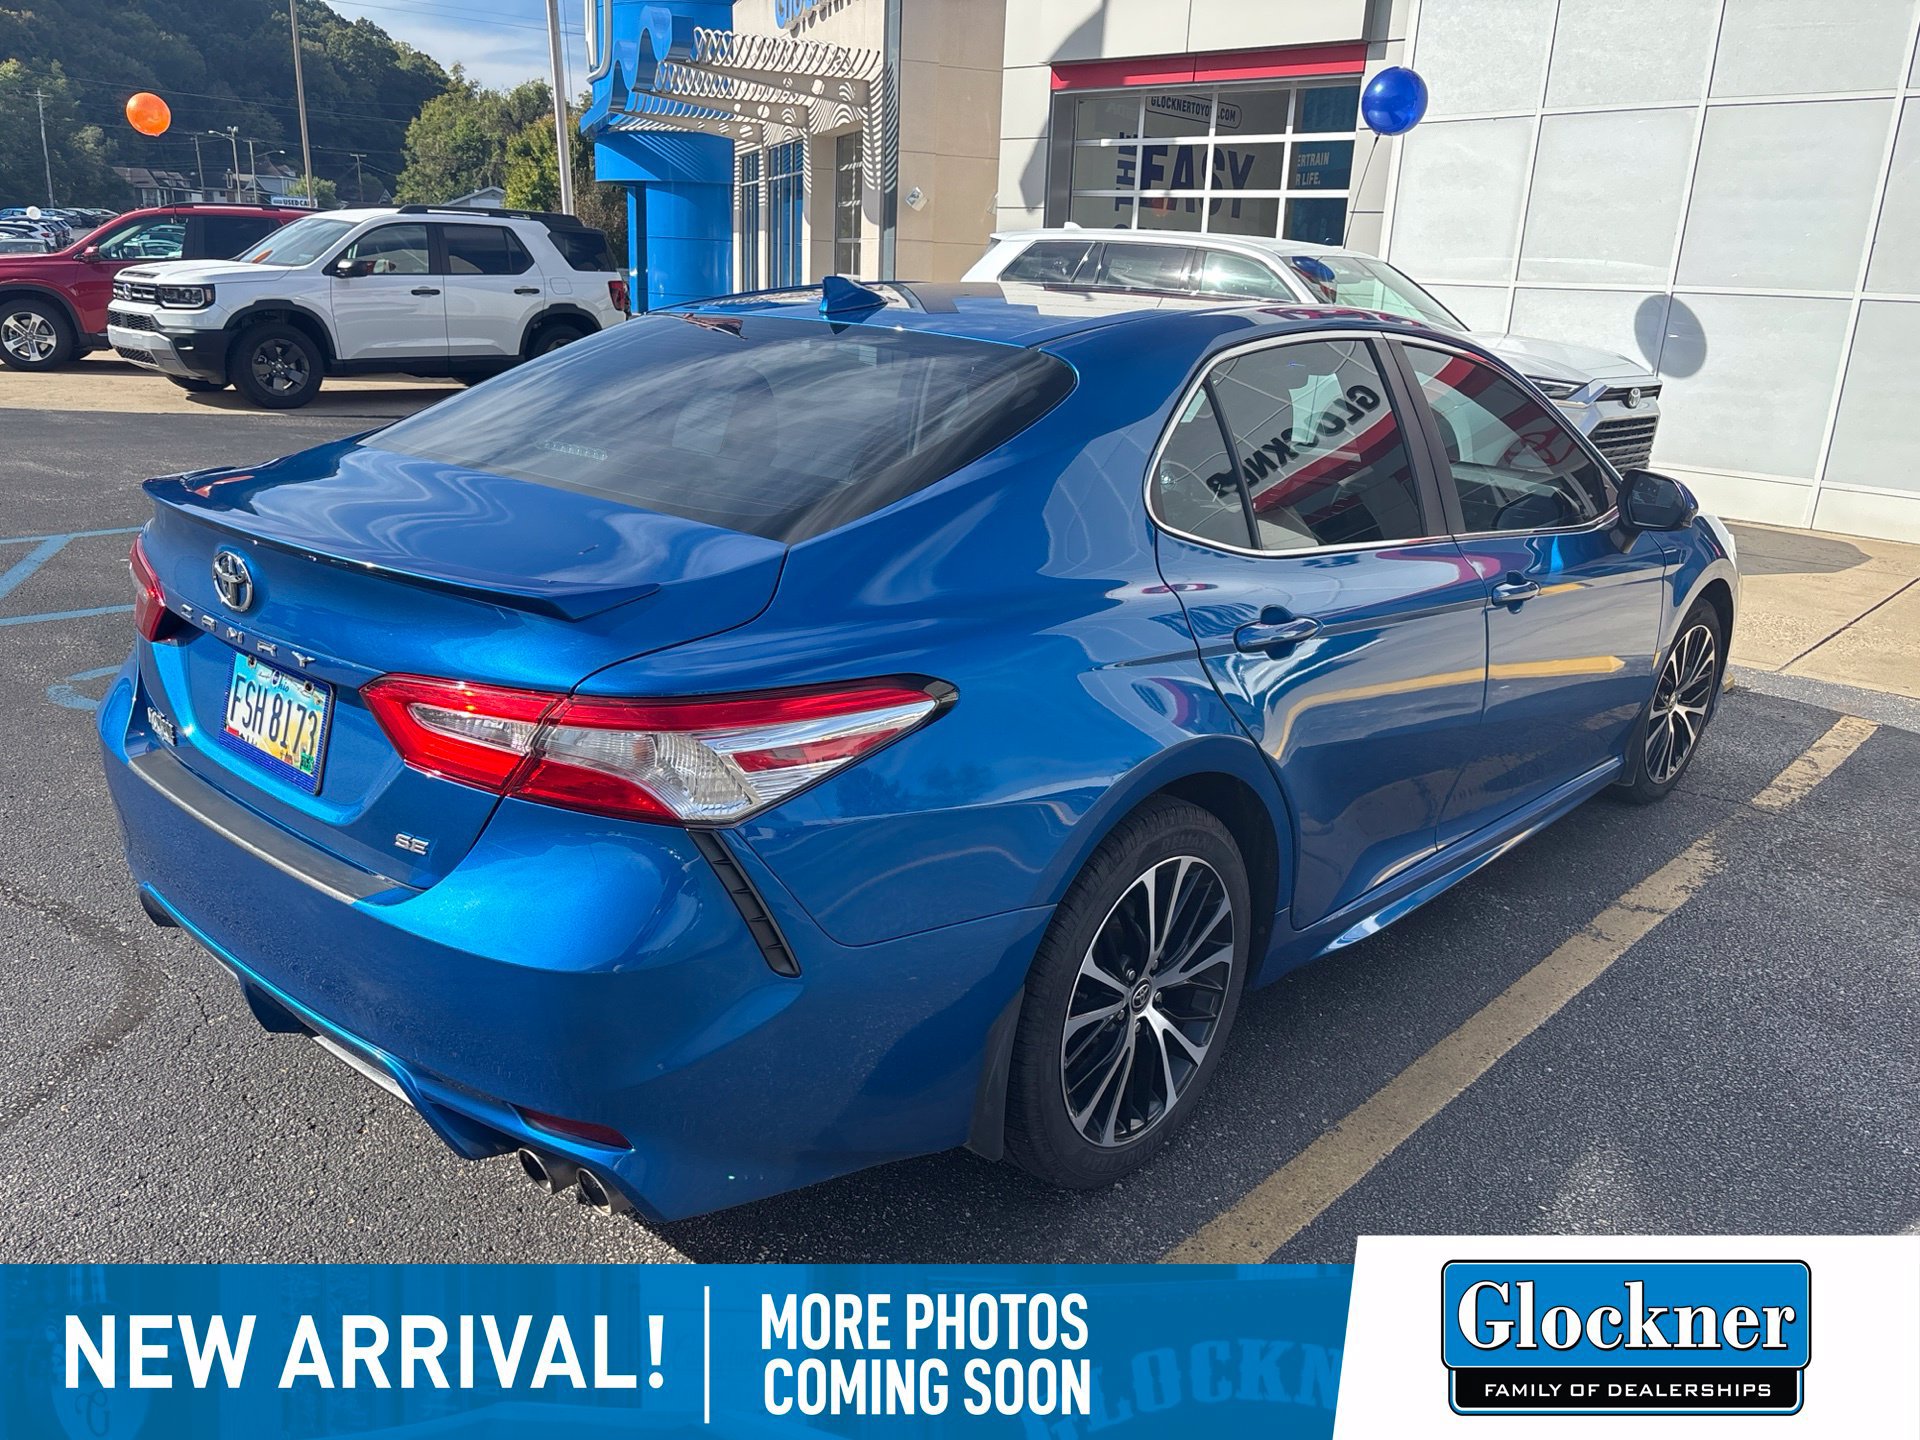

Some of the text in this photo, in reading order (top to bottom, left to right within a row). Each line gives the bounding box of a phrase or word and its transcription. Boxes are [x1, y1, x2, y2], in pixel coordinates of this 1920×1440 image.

[1151, 96, 1236, 122] GLOCKNERTOYO.COM
[1139, 136, 1256, 219] EASY
[1301, 172, 1321, 186] LIFE.
[180, 603, 316, 667] CAMRY
[229, 673, 268, 736] FSH
[268, 692, 318, 756] 8173
[394, 832, 430, 856] SE
